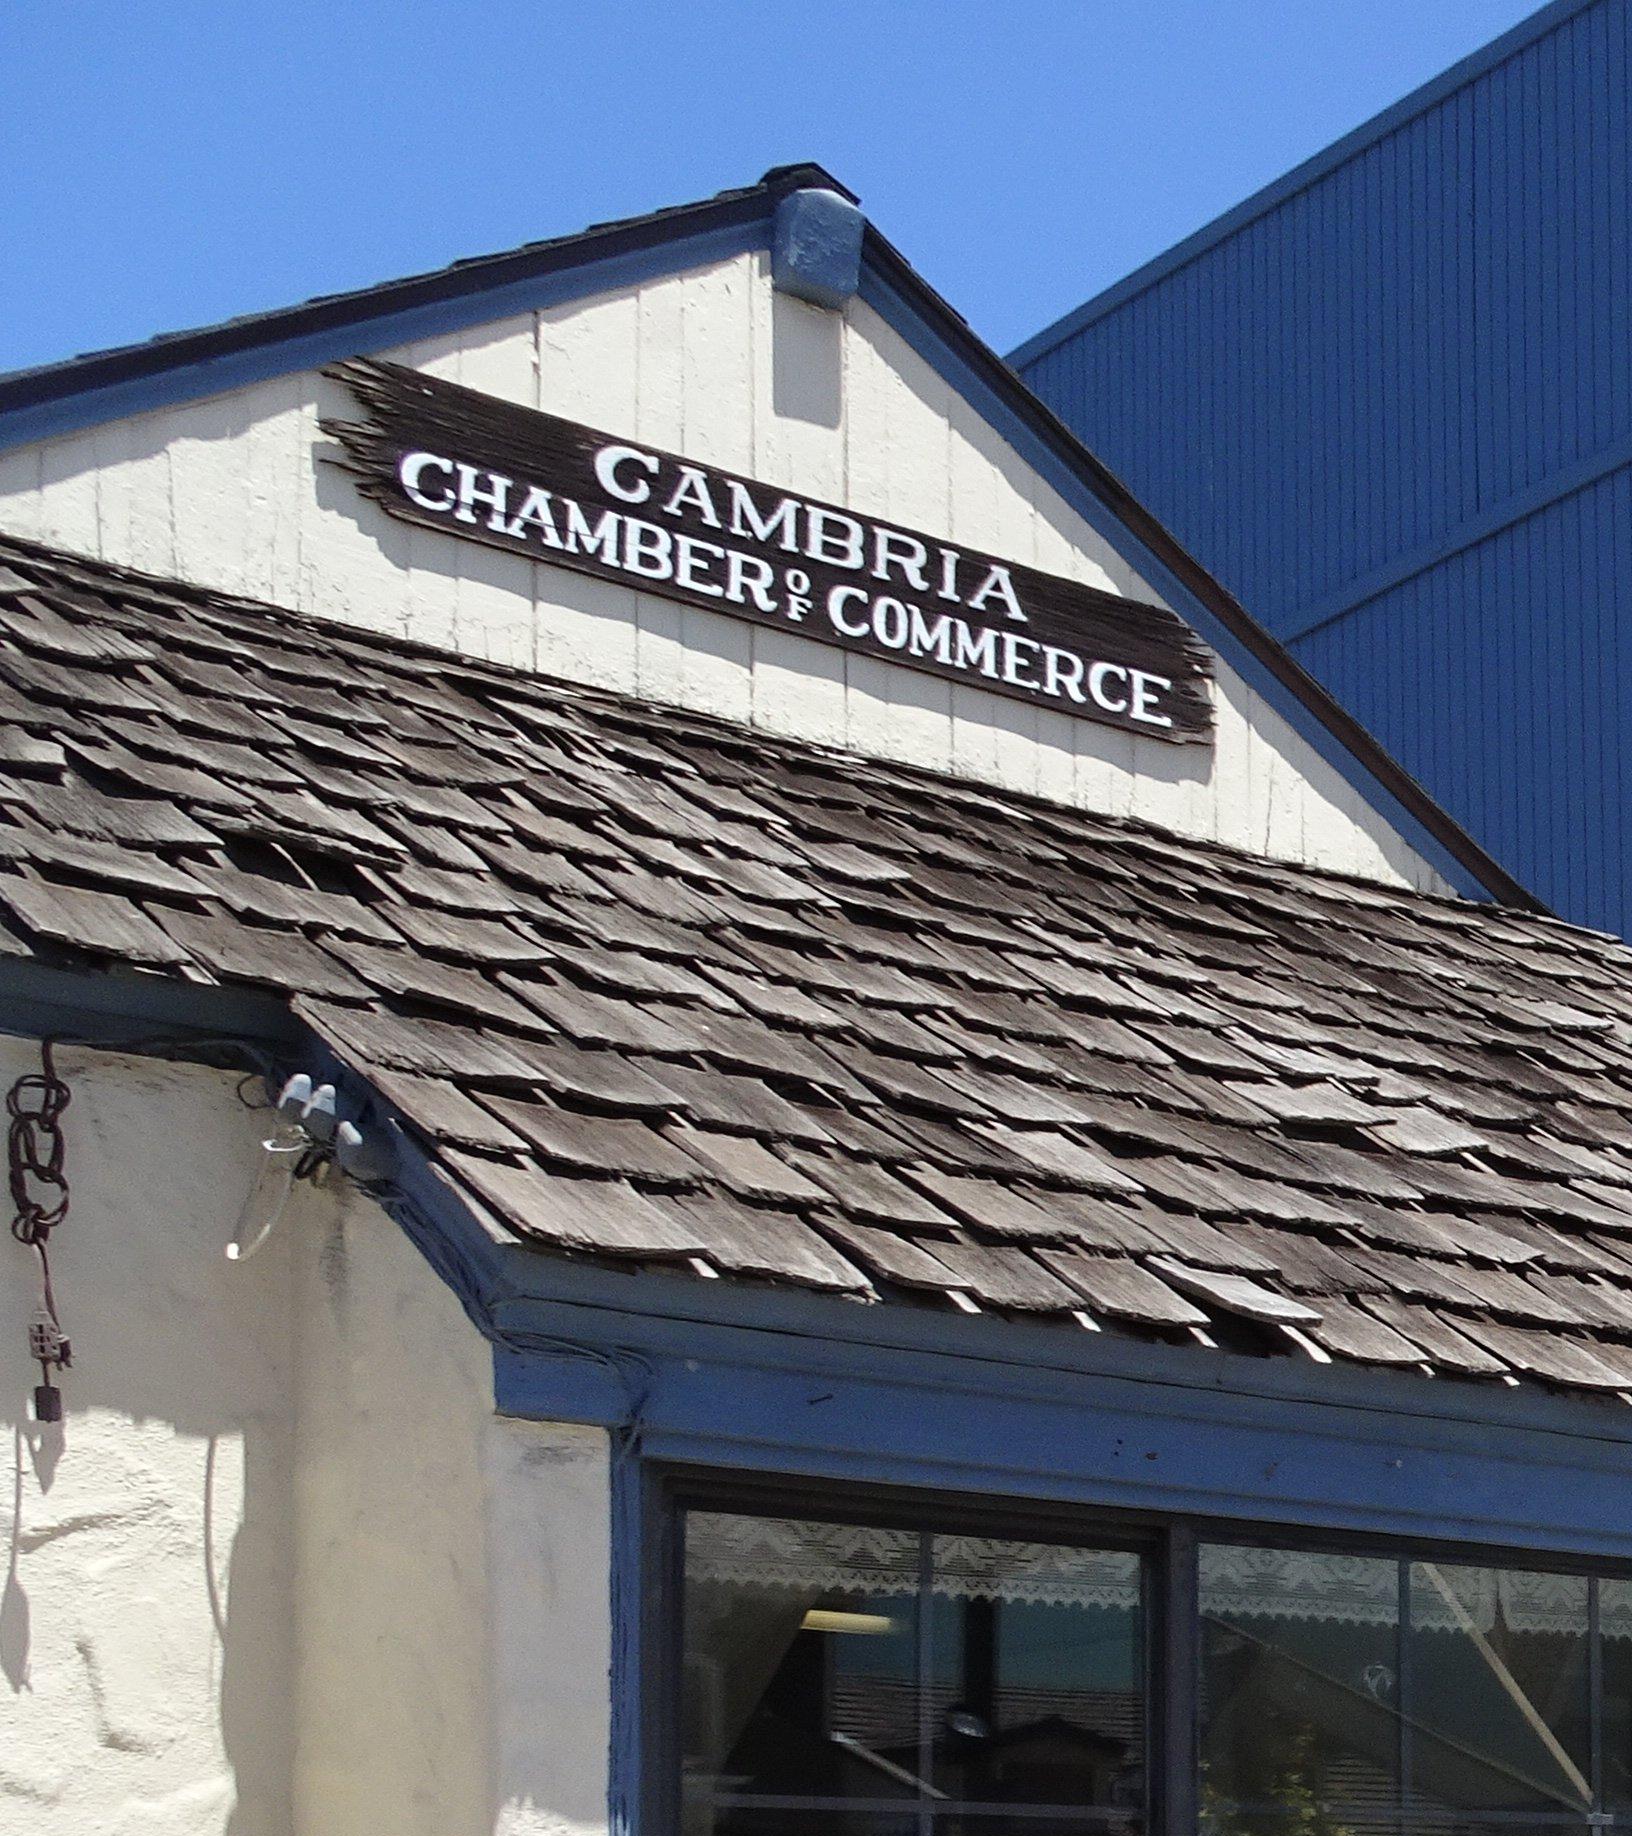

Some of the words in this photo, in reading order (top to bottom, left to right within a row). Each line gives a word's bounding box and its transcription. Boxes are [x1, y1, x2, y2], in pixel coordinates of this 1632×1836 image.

[400, 452, 777, 622] CHAMBER
[787, 568, 811, 621] OF
[829, 583, 1172, 728] COMMERCE
[596, 446, 1028, 622] CAMBRIA
